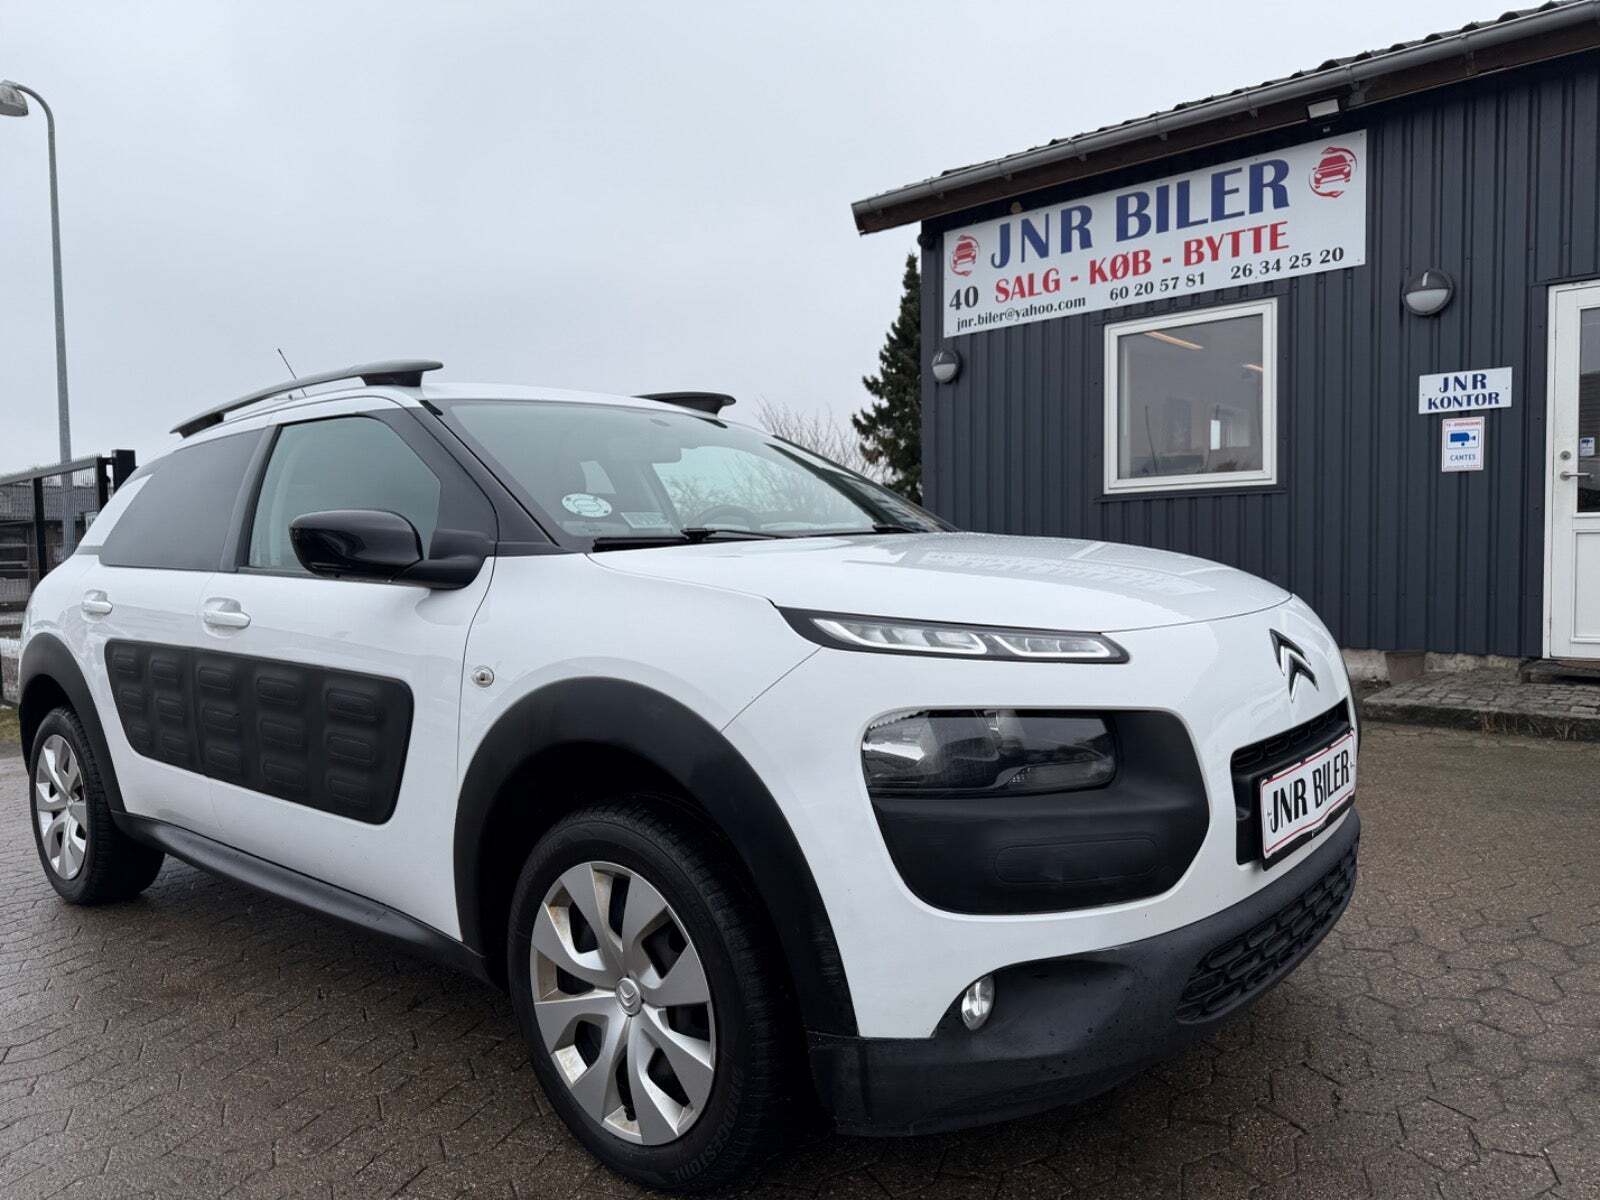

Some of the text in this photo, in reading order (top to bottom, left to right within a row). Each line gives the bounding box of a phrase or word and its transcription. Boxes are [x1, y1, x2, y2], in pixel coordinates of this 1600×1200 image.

[991, 158, 1290, 269] JNR BILER
[994, 268, 1061, 303] SALG
[1089, 249, 1152, 285] KØB
[1183, 221, 1290, 267] BYTTE
[1230, 247, 1344, 280] 26 34 25 20
[949, 285, 979, 310] 40
[1110, 272, 1205, 302] 60 20 57 81
[957, 296, 1086, 331] jnr.biler@yahoo.com
[1439, 373, 1488, 393] JNR
[1427, 392, 1500, 410] KONTOR
[1271, 749, 1350, 833] JNR BILER
